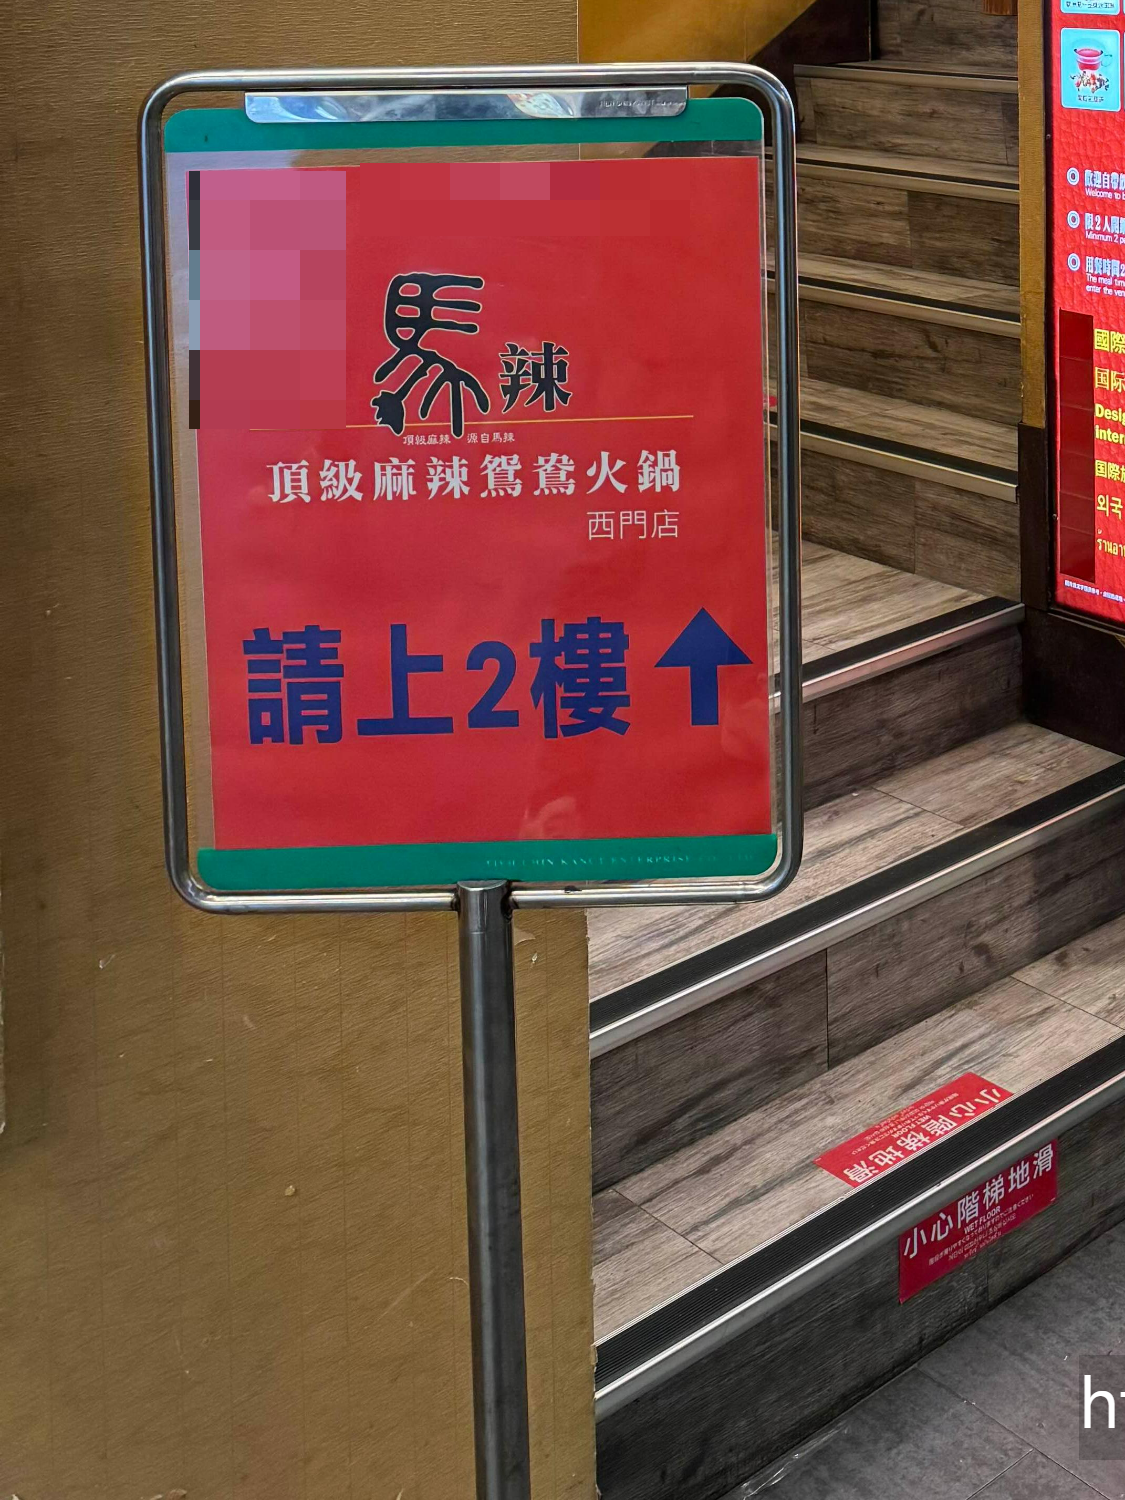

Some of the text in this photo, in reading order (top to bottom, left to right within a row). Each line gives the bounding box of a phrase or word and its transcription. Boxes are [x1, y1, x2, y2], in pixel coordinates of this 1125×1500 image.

[1085, 187, 1114, 199] Welcome
[1085, 231, 1113, 244] Minimum
[1085, 273, 1098, 283] The
[265, 448, 683, 505] 頂級麻辣鴛鴦火鍋
[1096, 494, 1124, 520] 외국
[586, 508, 681, 542] 西門店
[241, 615, 632, 746] 請上2樓
[843, 1087, 1001, 1184] 小心階梯地滑
[903, 1143, 1053, 1260] 小心階梯地滑
[963, 1205, 1001, 1235] WET FLOOR
